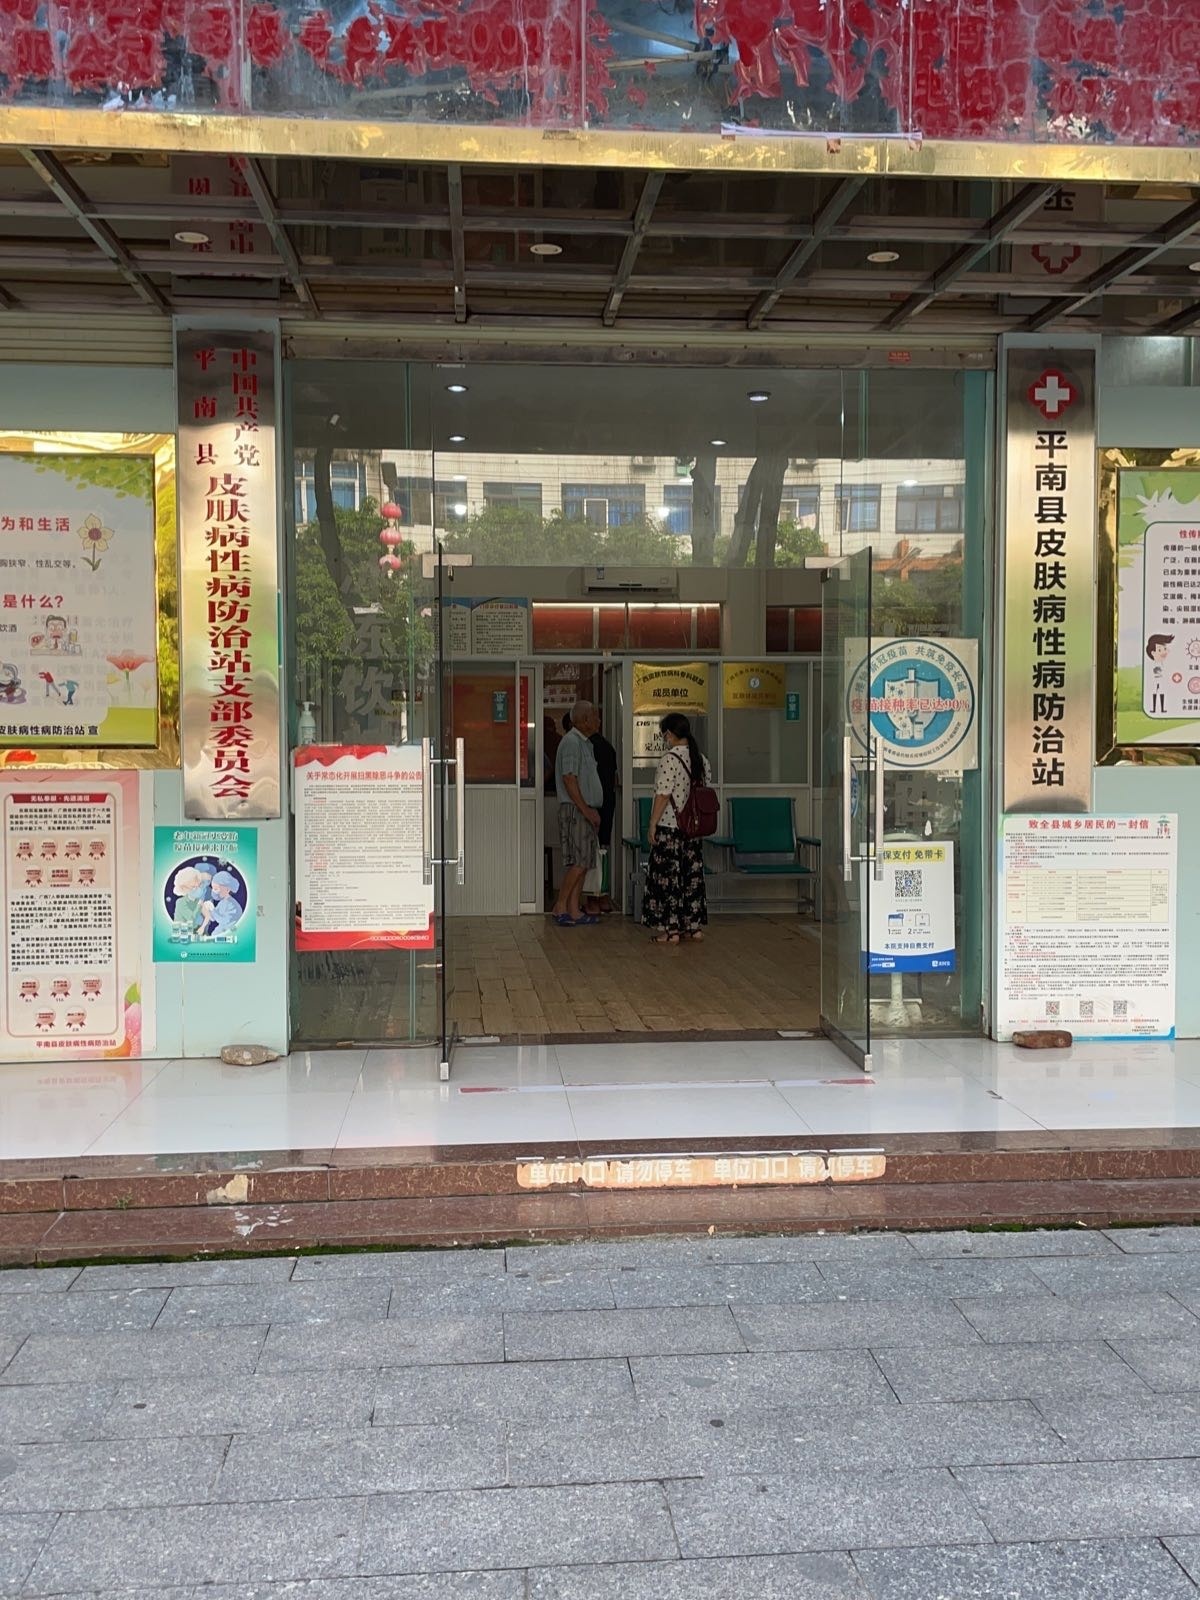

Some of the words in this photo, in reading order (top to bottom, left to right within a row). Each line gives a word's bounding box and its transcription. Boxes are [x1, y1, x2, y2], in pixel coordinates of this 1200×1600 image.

[193, 348, 219, 465] 平南县
[232, 348, 260, 467] 中国共产党
[1, 516, 70, 533] 为和生活
[1032, 430, 1068, 787] 平南县皮肤病性病防治站
[204, 472, 256, 798] 皮肤病性病防治站支部委员会
[652, 687, 689, 698] 成员单位
[915, 645, 968, 693] 共筑免疫长城
[1028, 819, 1150, 831] 致全县城乡居民的一封信
[879, 850, 911, 860] 保支付
